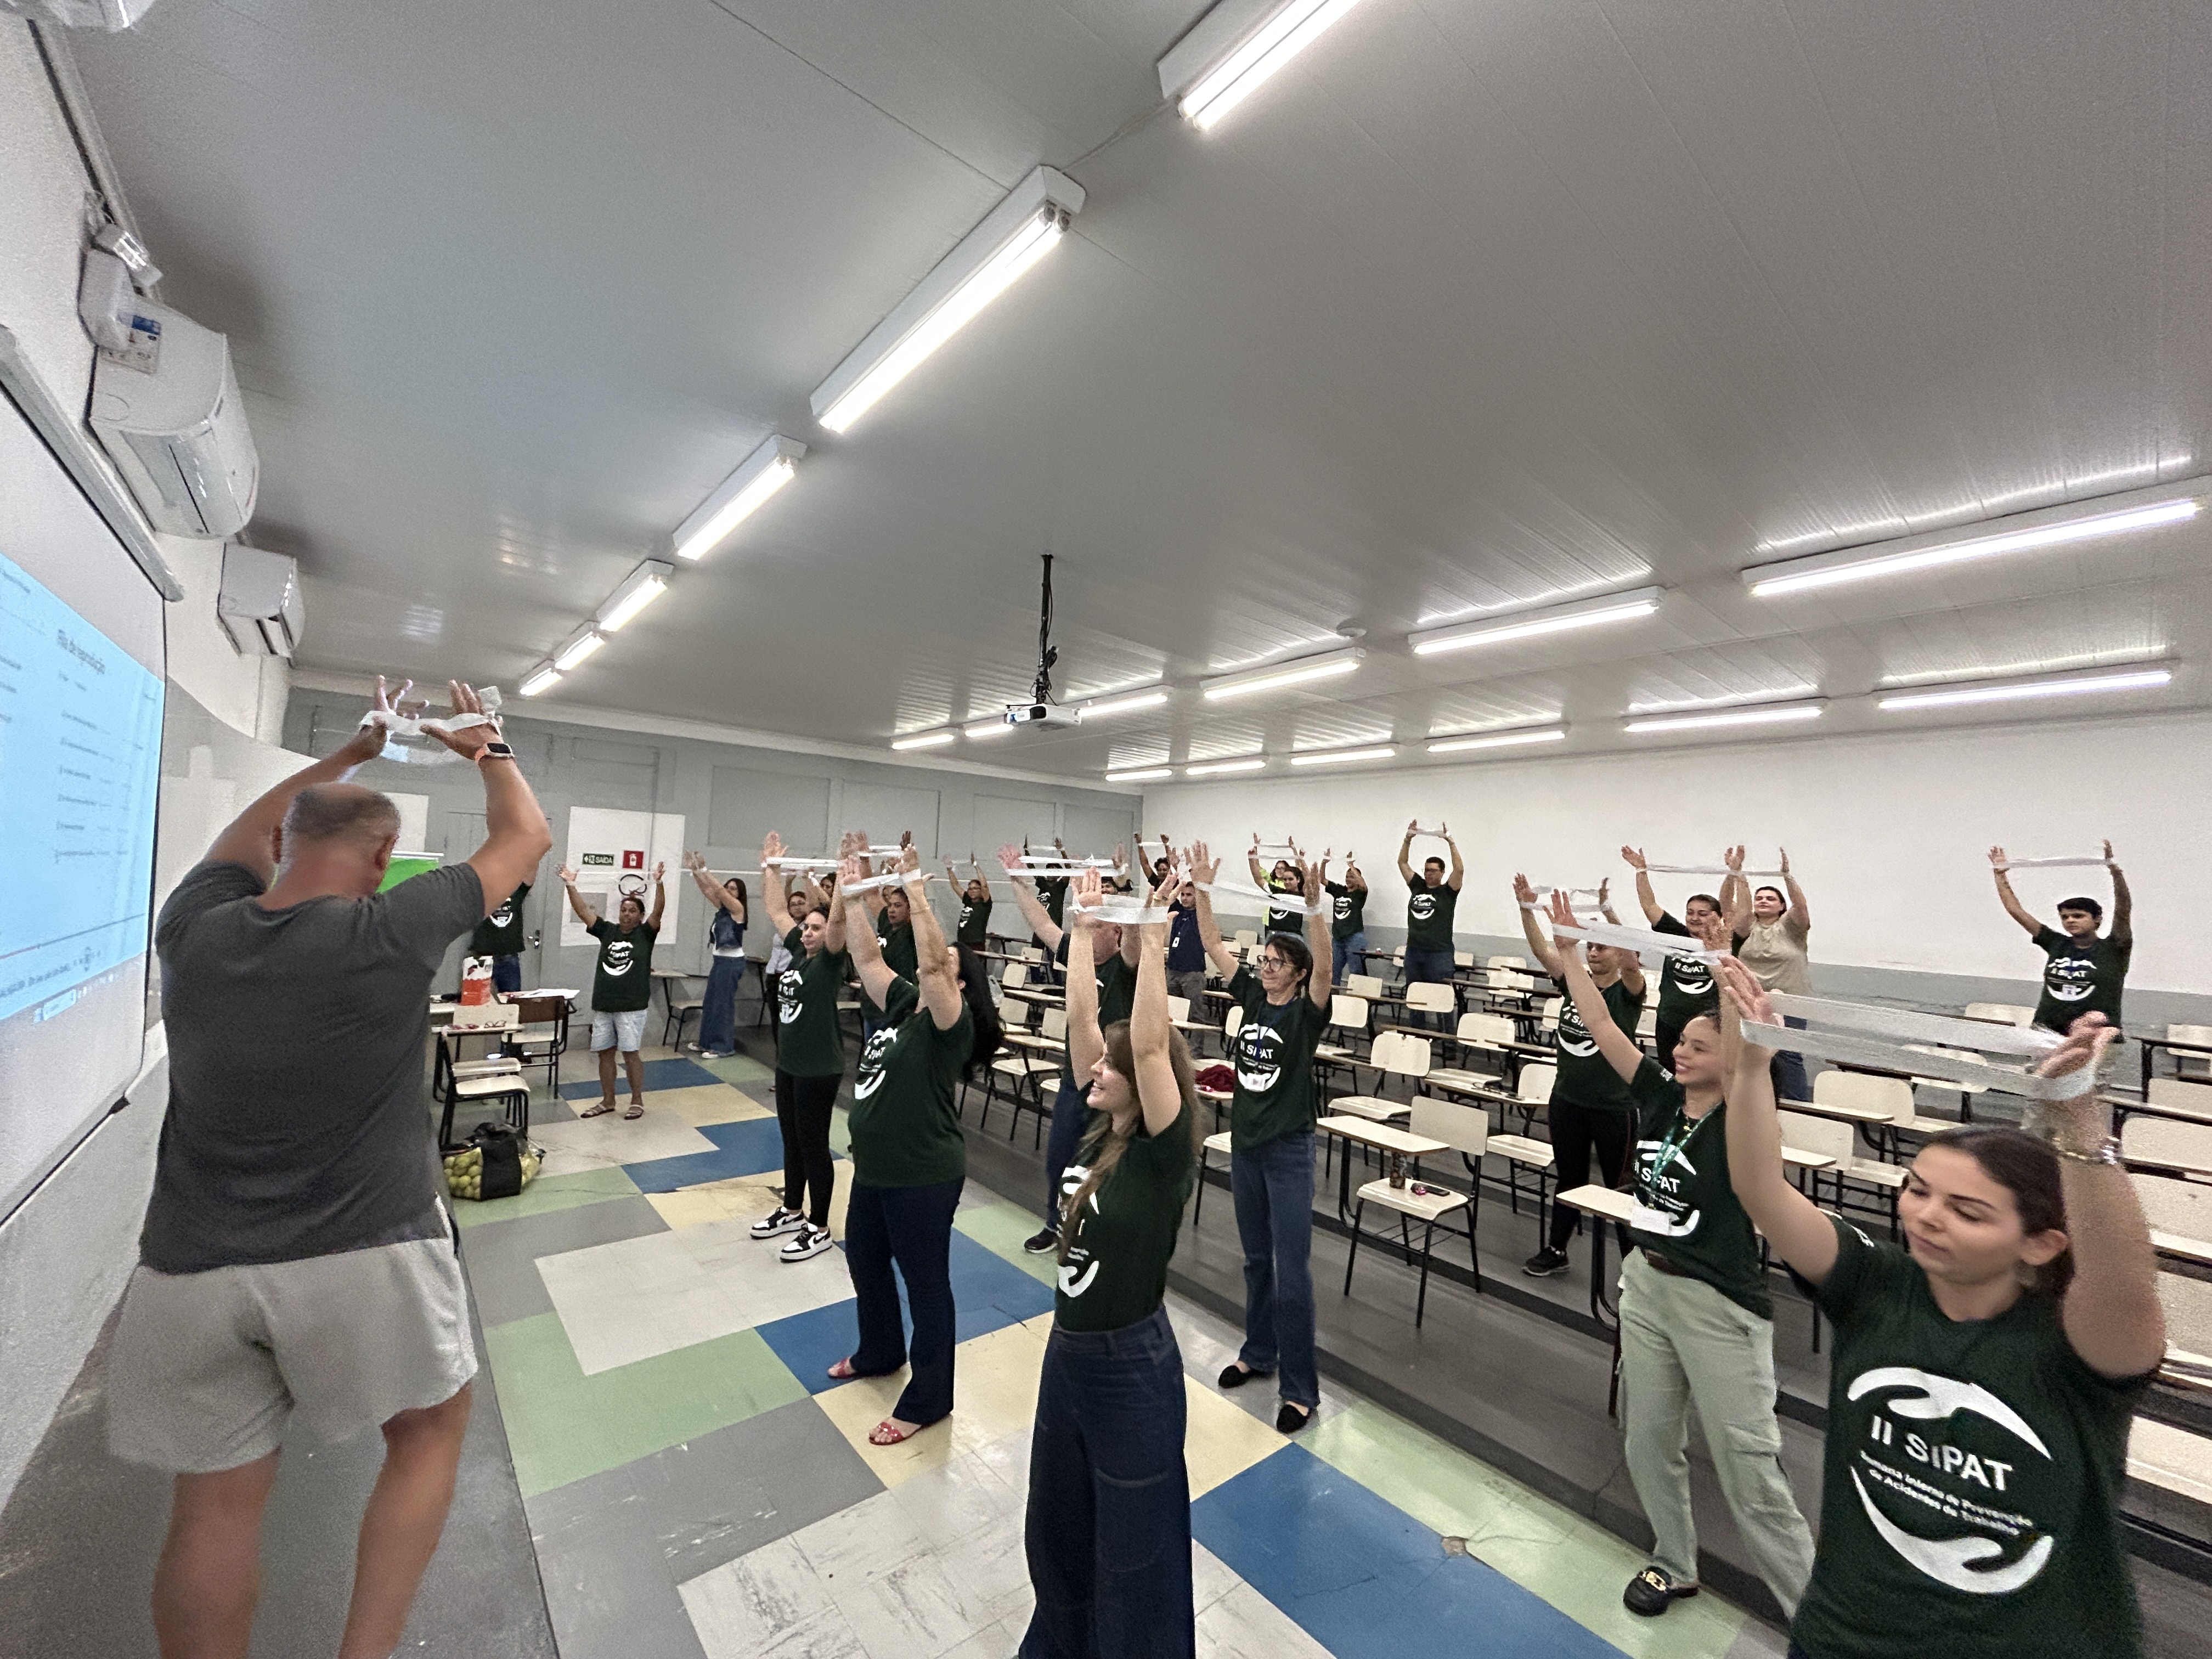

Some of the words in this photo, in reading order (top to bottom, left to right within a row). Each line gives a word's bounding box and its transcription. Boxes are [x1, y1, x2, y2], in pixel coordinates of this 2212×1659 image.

[1246, 1045, 1274, 1059] SIAT
[1641, 1167, 1680, 1193] SAT
[1871, 1415, 1893, 1445] II
[1904, 1432, 2013, 1491] SIPAT
